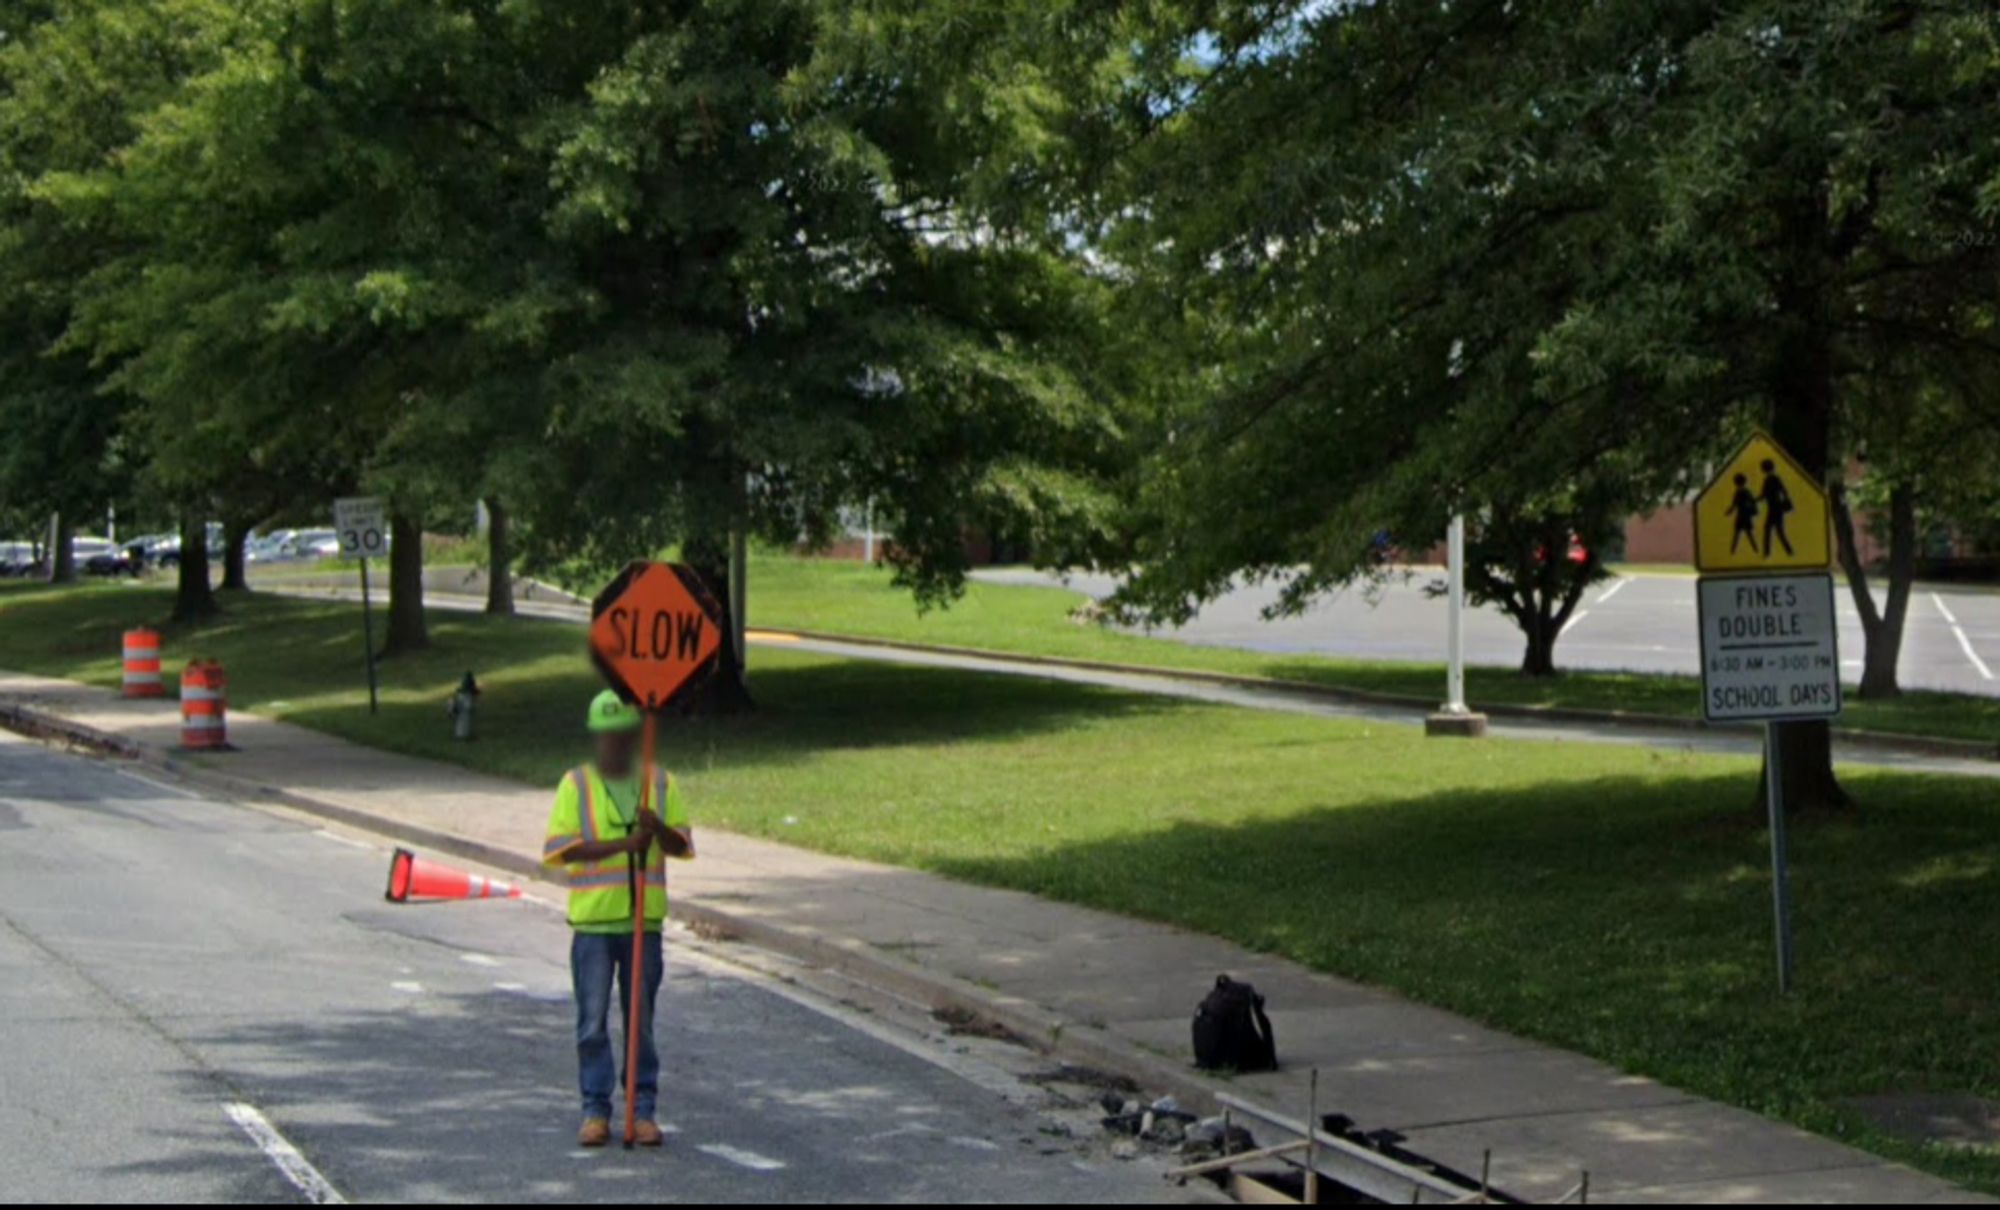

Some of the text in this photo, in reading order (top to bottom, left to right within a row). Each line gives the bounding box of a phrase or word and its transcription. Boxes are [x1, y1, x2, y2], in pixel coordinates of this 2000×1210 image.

[343, 528, 381, 551] 30
[1736, 586, 1797, 608] FINES
[610, 607, 703, 661] SLOW
[1719, 613, 1802, 638] DOUBLE
[1745, 656, 1763, 670] AM
[1815, 654, 1831, 669] PM
[1713, 683, 1831, 709] SCHOOL DAYS
